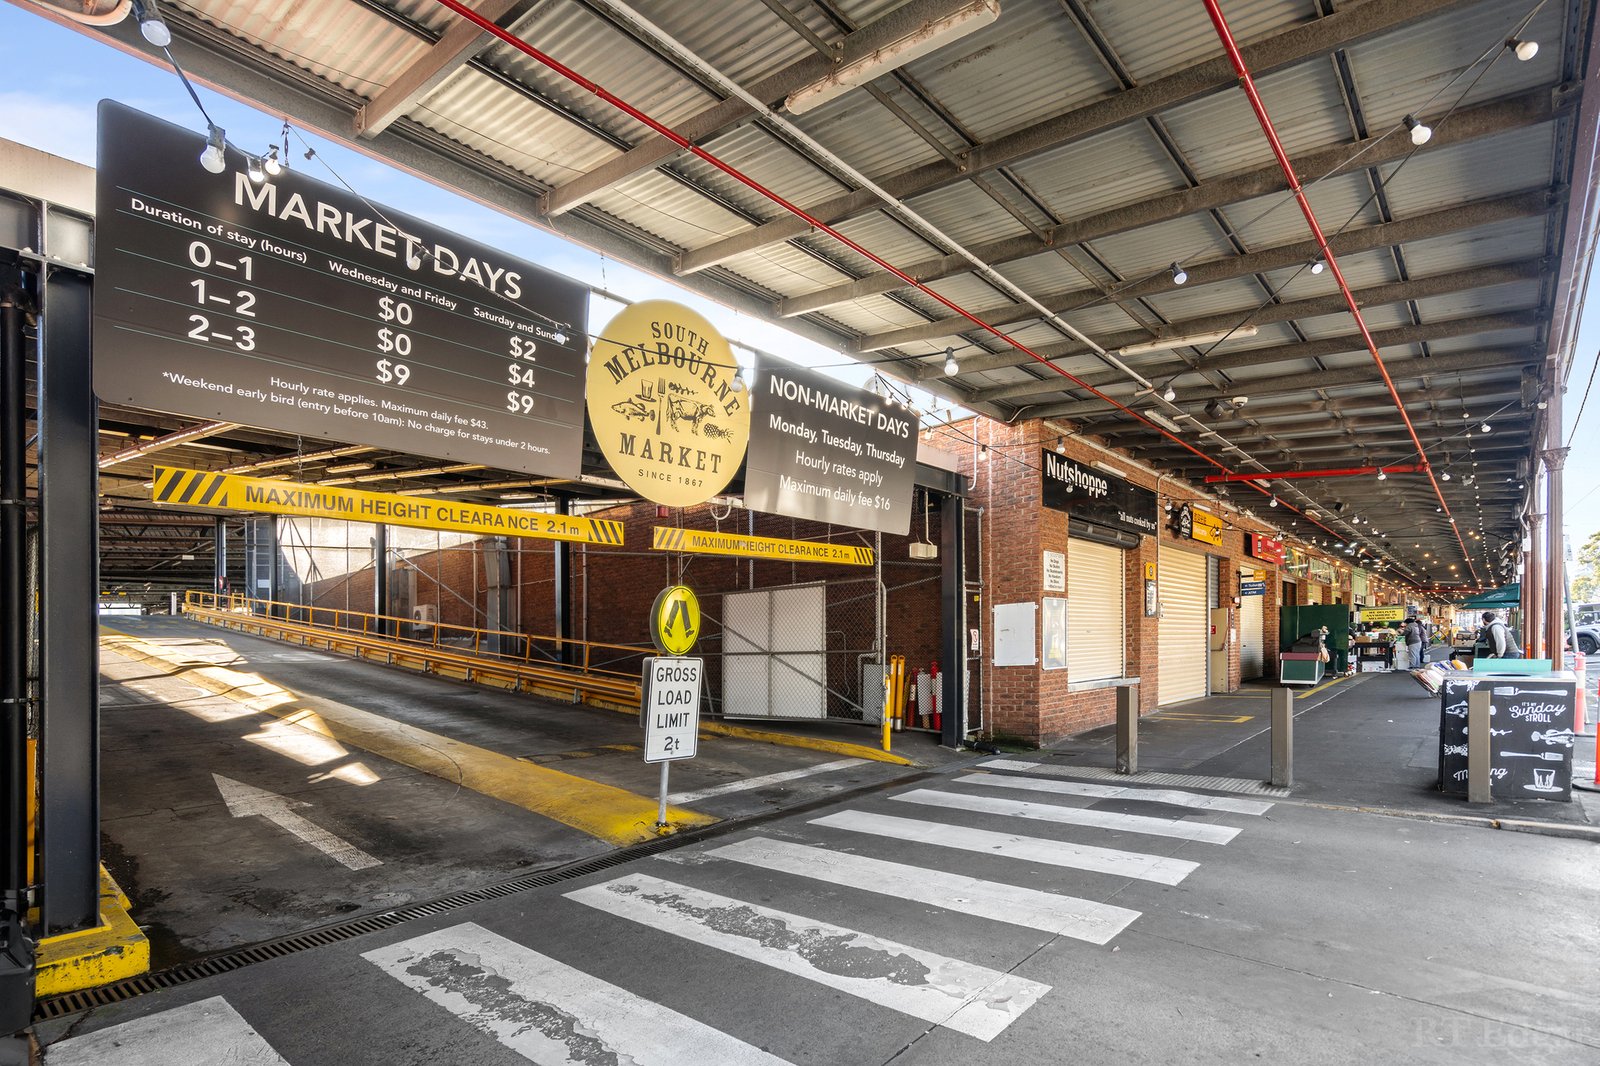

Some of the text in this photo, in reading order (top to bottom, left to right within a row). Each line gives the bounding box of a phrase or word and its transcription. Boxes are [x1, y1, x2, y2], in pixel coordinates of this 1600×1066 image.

[131, 198, 307, 263] Duration of stay (hours)
[235, 172, 521, 299] MARKET DAYS
[329, 260, 457, 310] Wednesday and Friday
[378, 296, 413, 325] $0
[474, 307, 514, 328] Saturday
[517, 322, 534, 333] and
[377, 327, 412, 356] $0
[509, 335, 537, 361] $2
[651, 321, 709, 356] SOUTH
[376, 359, 410, 386] $9
[508, 363, 535, 388] $4
[603, 341, 741, 416] MELBOURNE
[271, 377, 489, 430] Hourly rate applies. Maximum daily fee $43.
[507, 390, 534, 414] $9
[770, 374, 909, 438] NON-MARKET DAYS
[237, 387, 267, 402] early
[270, 391, 295, 406] bird
[298, 398, 331, 414] (entry
[334, 404, 368, 420] before
[372, 413, 405, 428] 10am):
[408, 419, 422, 430] No
[425, 423, 455, 437] charge
[457, 429, 470, 439] for
[472, 433, 493, 444] stays
[495, 437, 518, 448] under
[521, 441, 526, 449] 2
[527, 442, 551, 455] hours.
[619, 432, 721, 473] MARKET
[769, 414, 905, 469] Monday, Tuesday, Thursday
[638, 468, 703, 488] SINCE 1867
[796, 450, 883, 488] Hourly rates apply
[1046, 452, 1108, 498] Nutshoppe
[246, 485, 354, 513] MAXIMUM
[361, 498, 432, 520] HEIGHT
[437, 507, 539, 531] CLEARANCE
[780, 474, 891, 511] Maximum daily fee $16
[692, 535, 740, 551] MAXIMUM
[778, 543, 829, 558] CLEARANCE
[656, 667, 697, 682] GROSS
[658, 690, 692, 705] LOAD
[1509, 702, 1567, 718] Sunday
[657, 712, 690, 729] LIMIT
[664, 736, 680, 751] 2t
